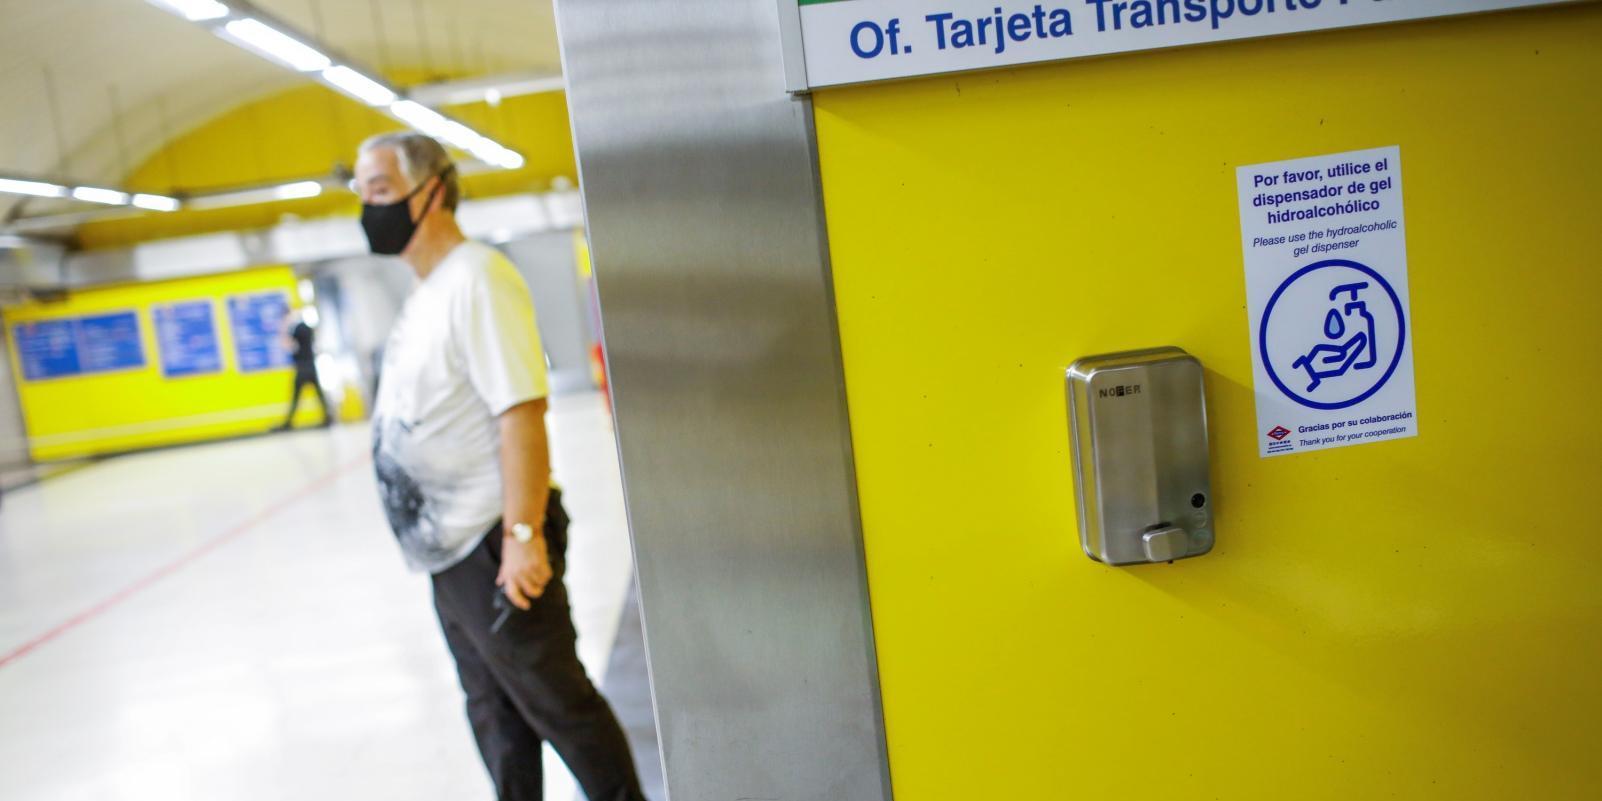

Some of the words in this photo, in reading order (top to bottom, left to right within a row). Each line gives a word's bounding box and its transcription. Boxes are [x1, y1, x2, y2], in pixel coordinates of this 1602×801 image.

[850, 18, 912, 59] Of.
[925, 7, 1073, 54] Tarjeta
[1085, 0, 1322, 32] Transpo
[1254, 175, 1279, 188] Por
[1283, 169, 1323, 183] favor,
[1327, 162, 1370, 177] utilice
[1375, 158, 1388, 171] el
[1253, 184, 1343, 207] dispensador
[1347, 181, 1366, 194] de
[1369, 177, 1392, 193] gel
[1268, 199, 1380, 224] hidroalcohólico
[1253, 237, 1286, 247] Please
[1288, 234, 1306, 242] use
[1308, 229, 1324, 240] the
[1326, 219, 1398, 237] hydroalcoholic
[1293, 244, 1309, 257] gel
[1311, 238, 1360, 254] dispenser
[1298, 422, 1330, 433] Gracias
[1331, 421, 1346, 430] por
[1347, 418, 1358, 426] su
[1359, 411, 1413, 425] colaboración
[1299, 438, 1321, 447] Thank
[1321, 436, 1335, 445] you
[1336, 434, 1347, 442] for
[1347, 432, 1363, 441] your
[1364, 426, 1407, 437] cooperation
